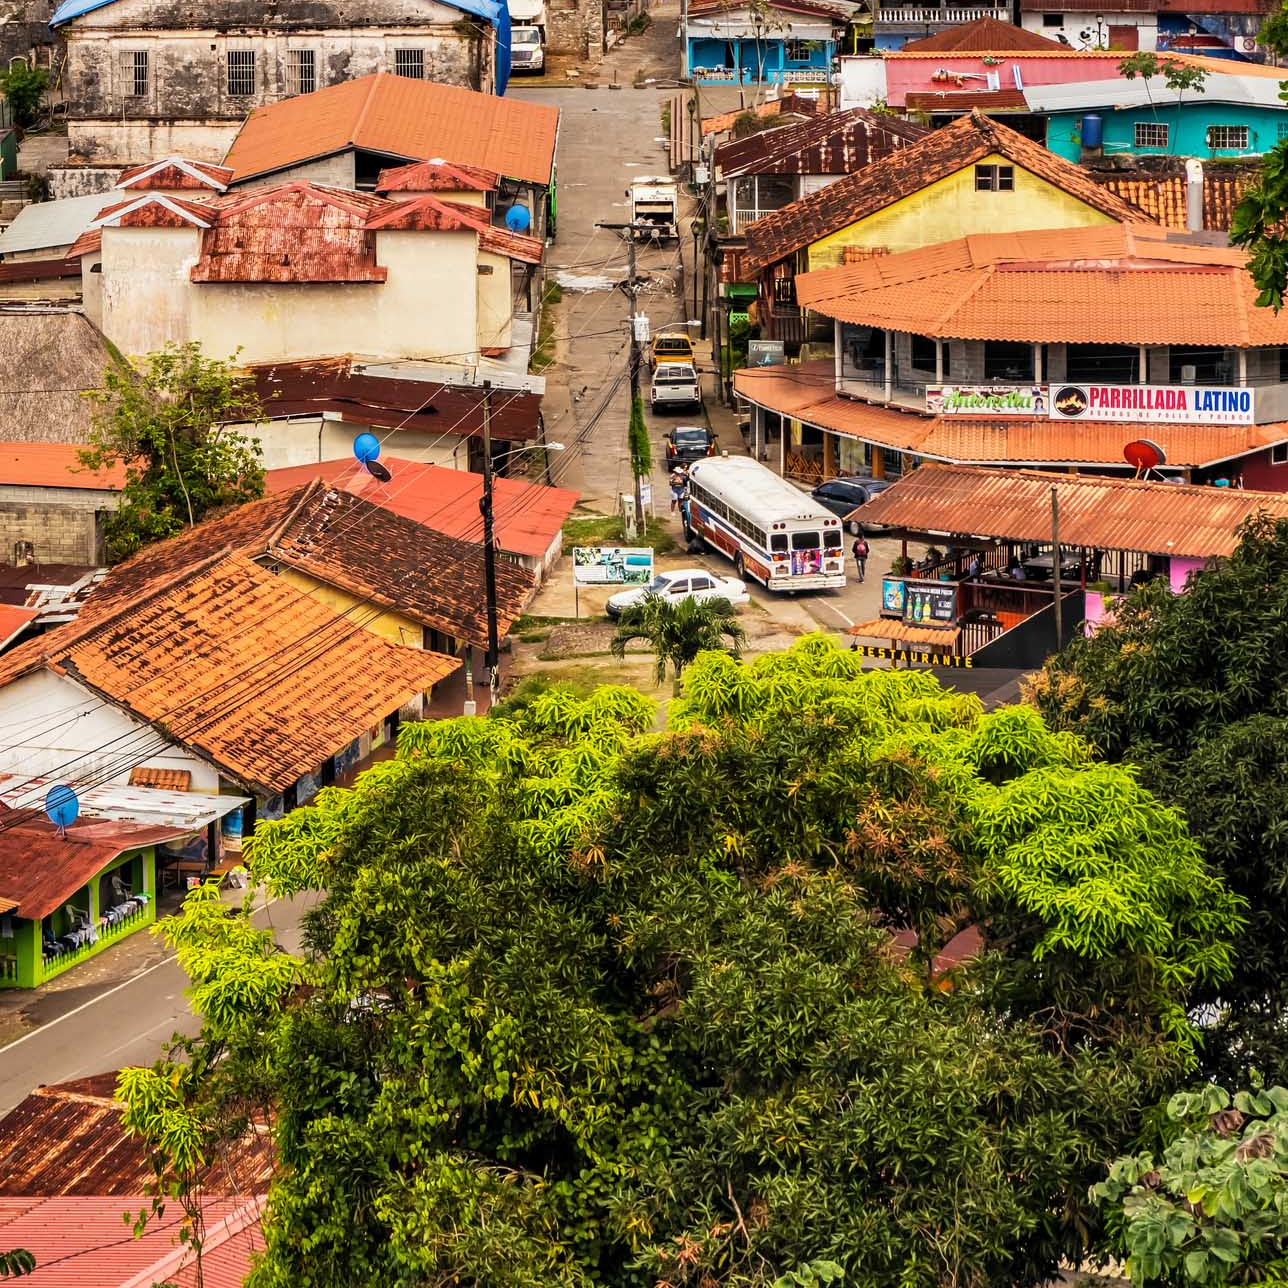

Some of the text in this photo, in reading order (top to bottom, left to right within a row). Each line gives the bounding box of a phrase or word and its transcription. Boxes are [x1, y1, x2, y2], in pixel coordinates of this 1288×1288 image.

[943, 391, 1033, 409] Antonella
[1089, 387, 1251, 413] PARRILLADA LATINO
[856, 644, 974, 669] RESTAURANTE
